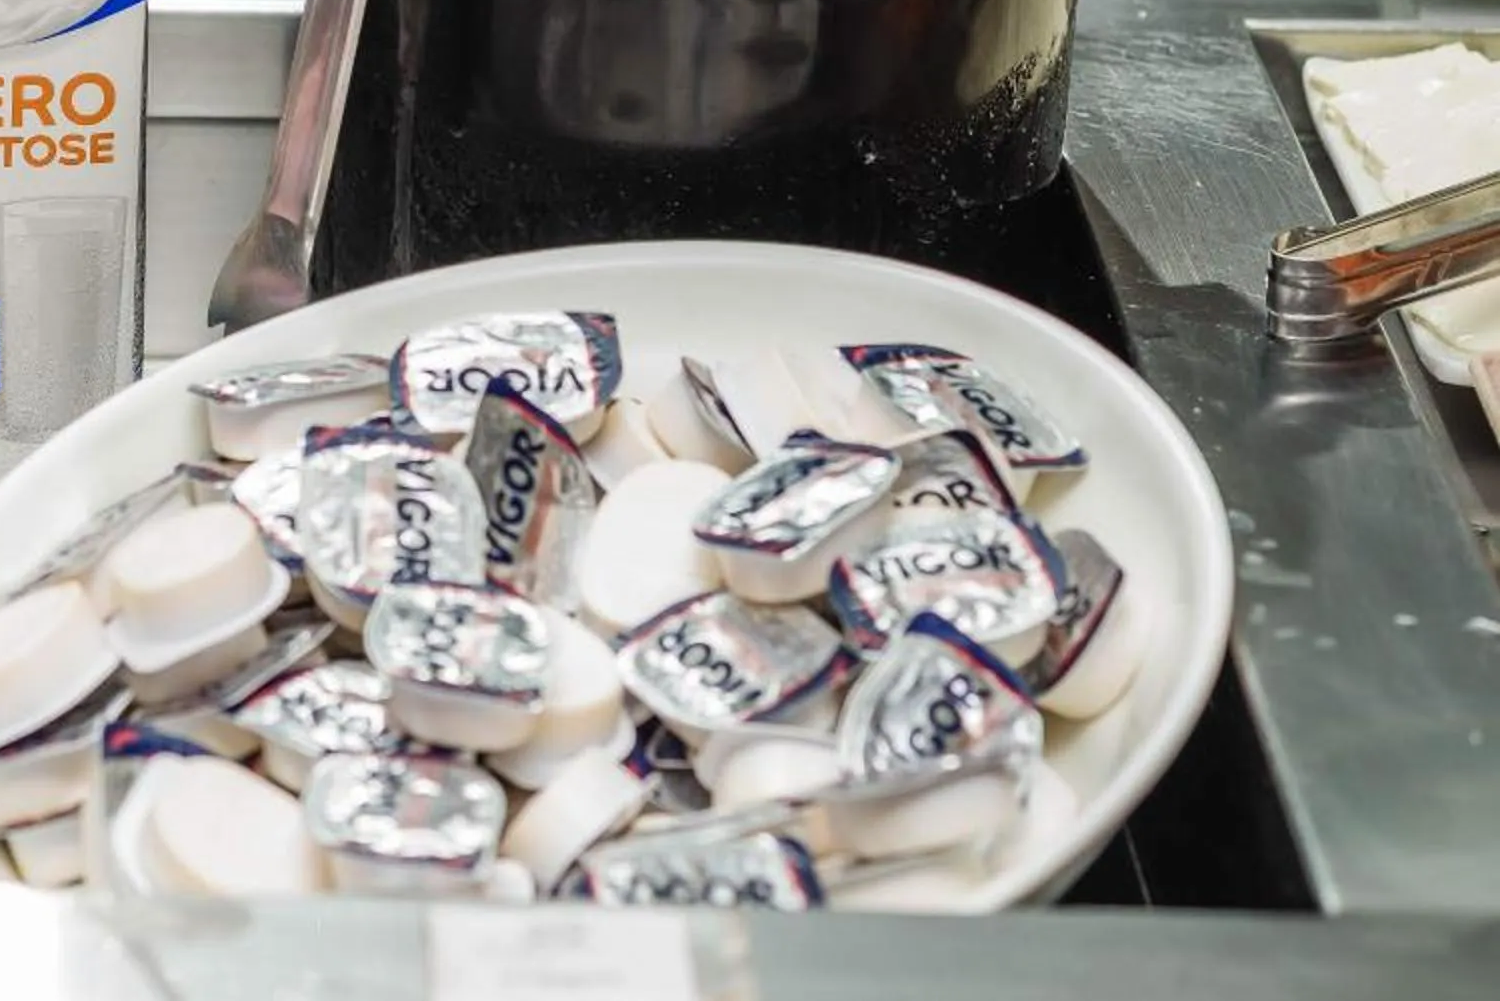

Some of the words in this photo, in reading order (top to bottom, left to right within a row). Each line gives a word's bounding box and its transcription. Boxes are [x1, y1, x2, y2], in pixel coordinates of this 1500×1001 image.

[930, 361, 1033, 453] VIGOR
[391, 458, 434, 584] VIGOR
[487, 429, 547, 567] VIGOR
[855, 544, 1023, 585] VIGOR
